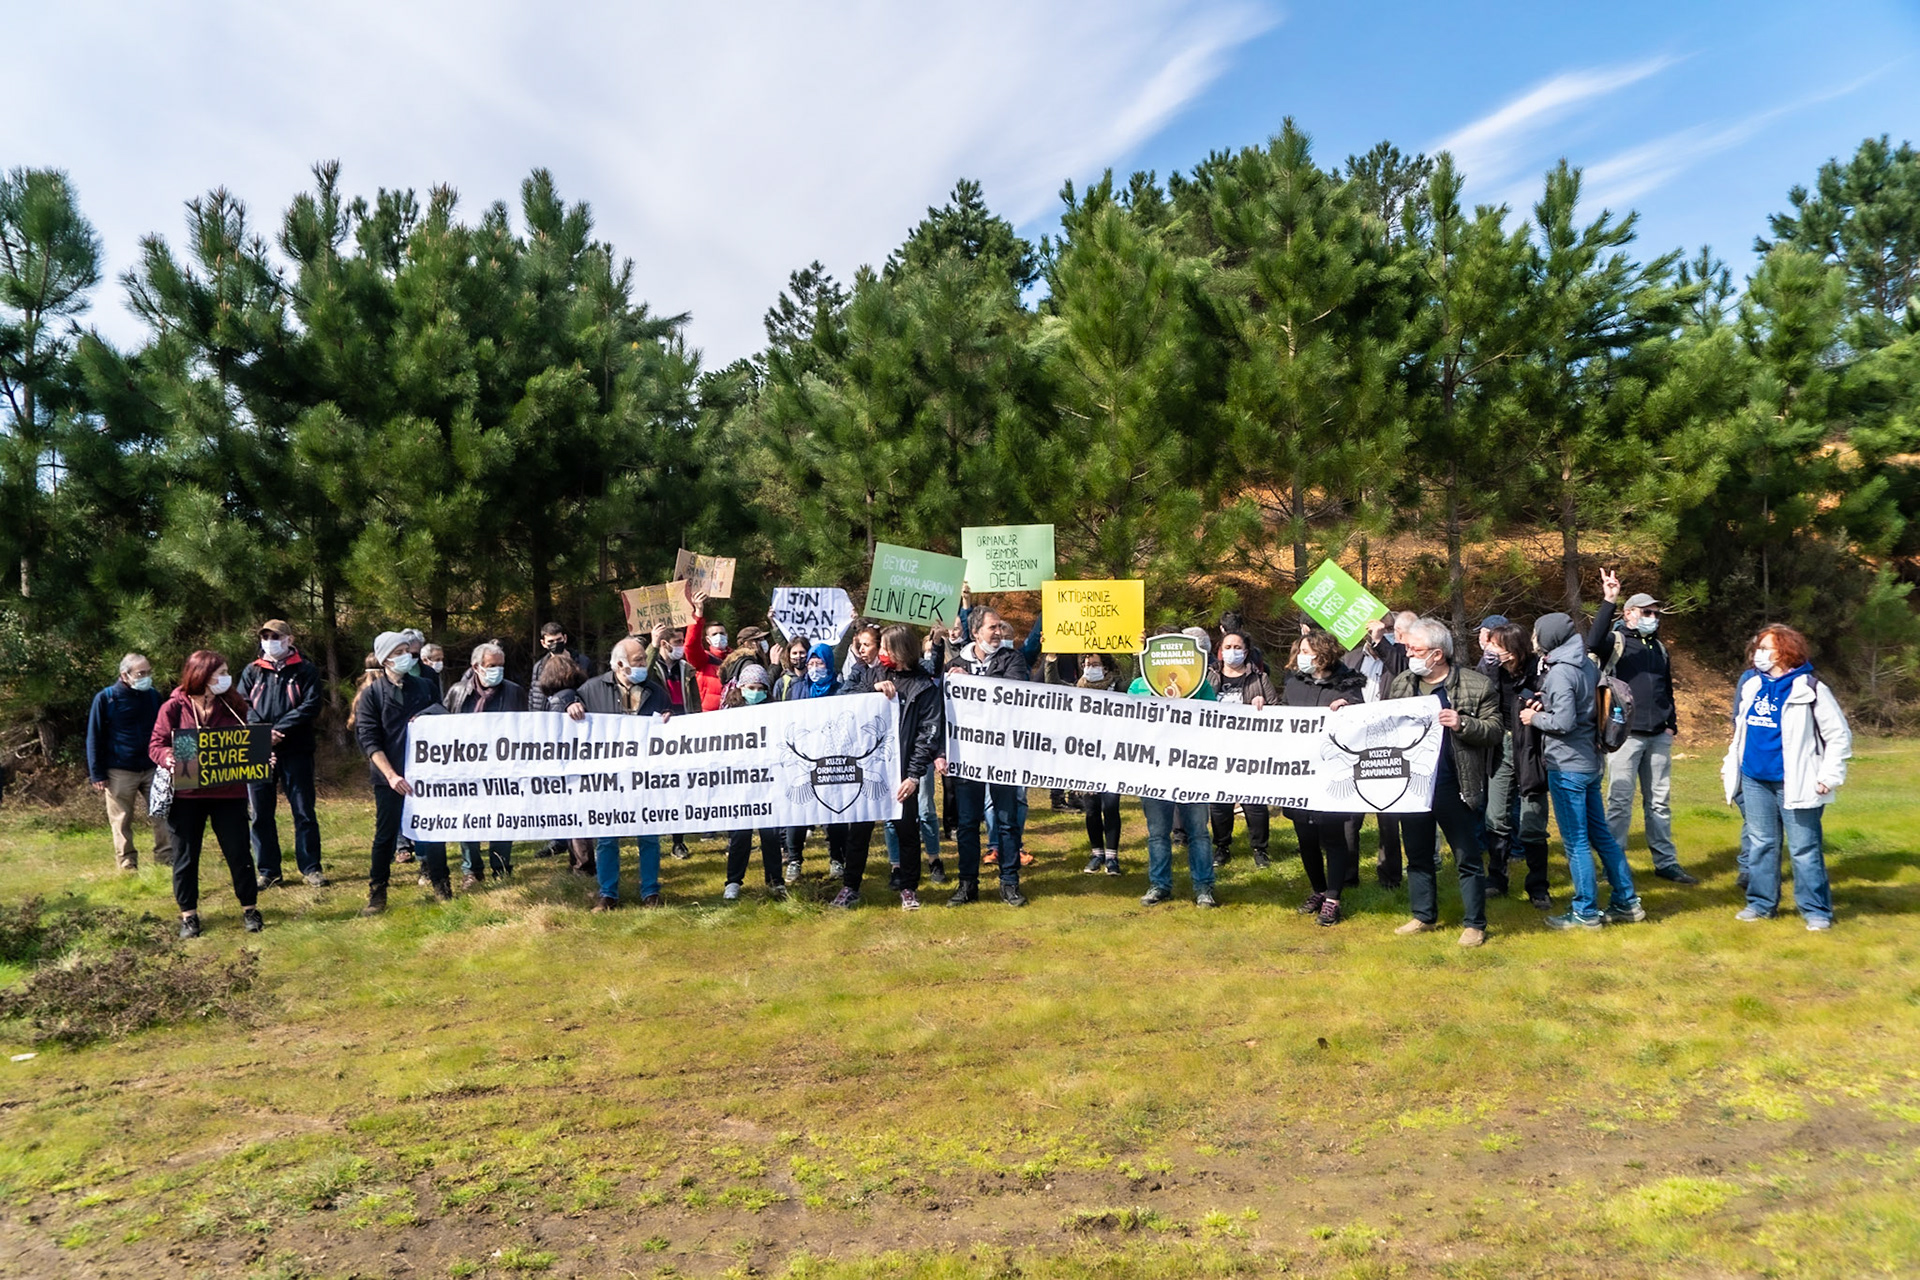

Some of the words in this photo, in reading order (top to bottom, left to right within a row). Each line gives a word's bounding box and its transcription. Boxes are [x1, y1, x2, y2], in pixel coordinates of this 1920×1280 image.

[976, 534, 1018, 547] ORMANLAR
[882, 554, 919, 573] BEYKOZ
[989, 571, 1027, 588] DEĞİL
[870, 588, 906, 615] ELİNİ
[908, 592, 946, 622] ÇEK
[1080, 604, 1120, 617] GİDECEK
[1084, 635, 1133, 649] KALACAK
[1151, 650, 1194, 658] ORMANLARI
[944, 680, 987, 702] Çevre
[993, 686, 1073, 711] Şehircilik
[1199, 708, 1284, 733] itirazımız
[1290, 716, 1326, 733] var!
[199, 730, 251, 748] BEYKOZ
[415, 739, 488, 765] Beykoz
[496, 737, 638, 762] Ormanlarına
[648, 726, 767, 757] Dokunma!
[198, 748, 249, 769] ÇEVRE
[825, 757, 847, 765] KUZEY
[1012, 730, 1057, 755] Villa,
[1064, 736, 1106, 760] Otel,
[1113, 742, 1160, 767] AVM,
[1168, 748, 1218, 771] Plaza
[1224, 758, 1316, 775] yapılmaz.
[1368, 749, 1392, 758] KUZEY
[816, 765, 856, 775] ORMANLARI
[948, 760, 982, 778] eykoz
[987, 765, 1017, 783] Kent
[1360, 758, 1402, 768] ORMANLARI
[200, 764, 269, 786] SAVUNMASI
[414, 780, 478, 797] Ormana
[482, 778, 525, 797] Villa,
[531, 776, 572, 795] Otel,
[579, 772, 624, 793] AVM,
[632, 771, 680, 790] Plaza
[687, 767, 775, 789] yapılmaz.
[410, 814, 457, 831] Beykoz
[462, 813, 491, 830] Kent
[497, 812, 583, 830] Dayanışması,
[588, 808, 636, 826] Beykoz
[642, 807, 679, 824] Çevre
[685, 802, 772, 821] Dayanışması
